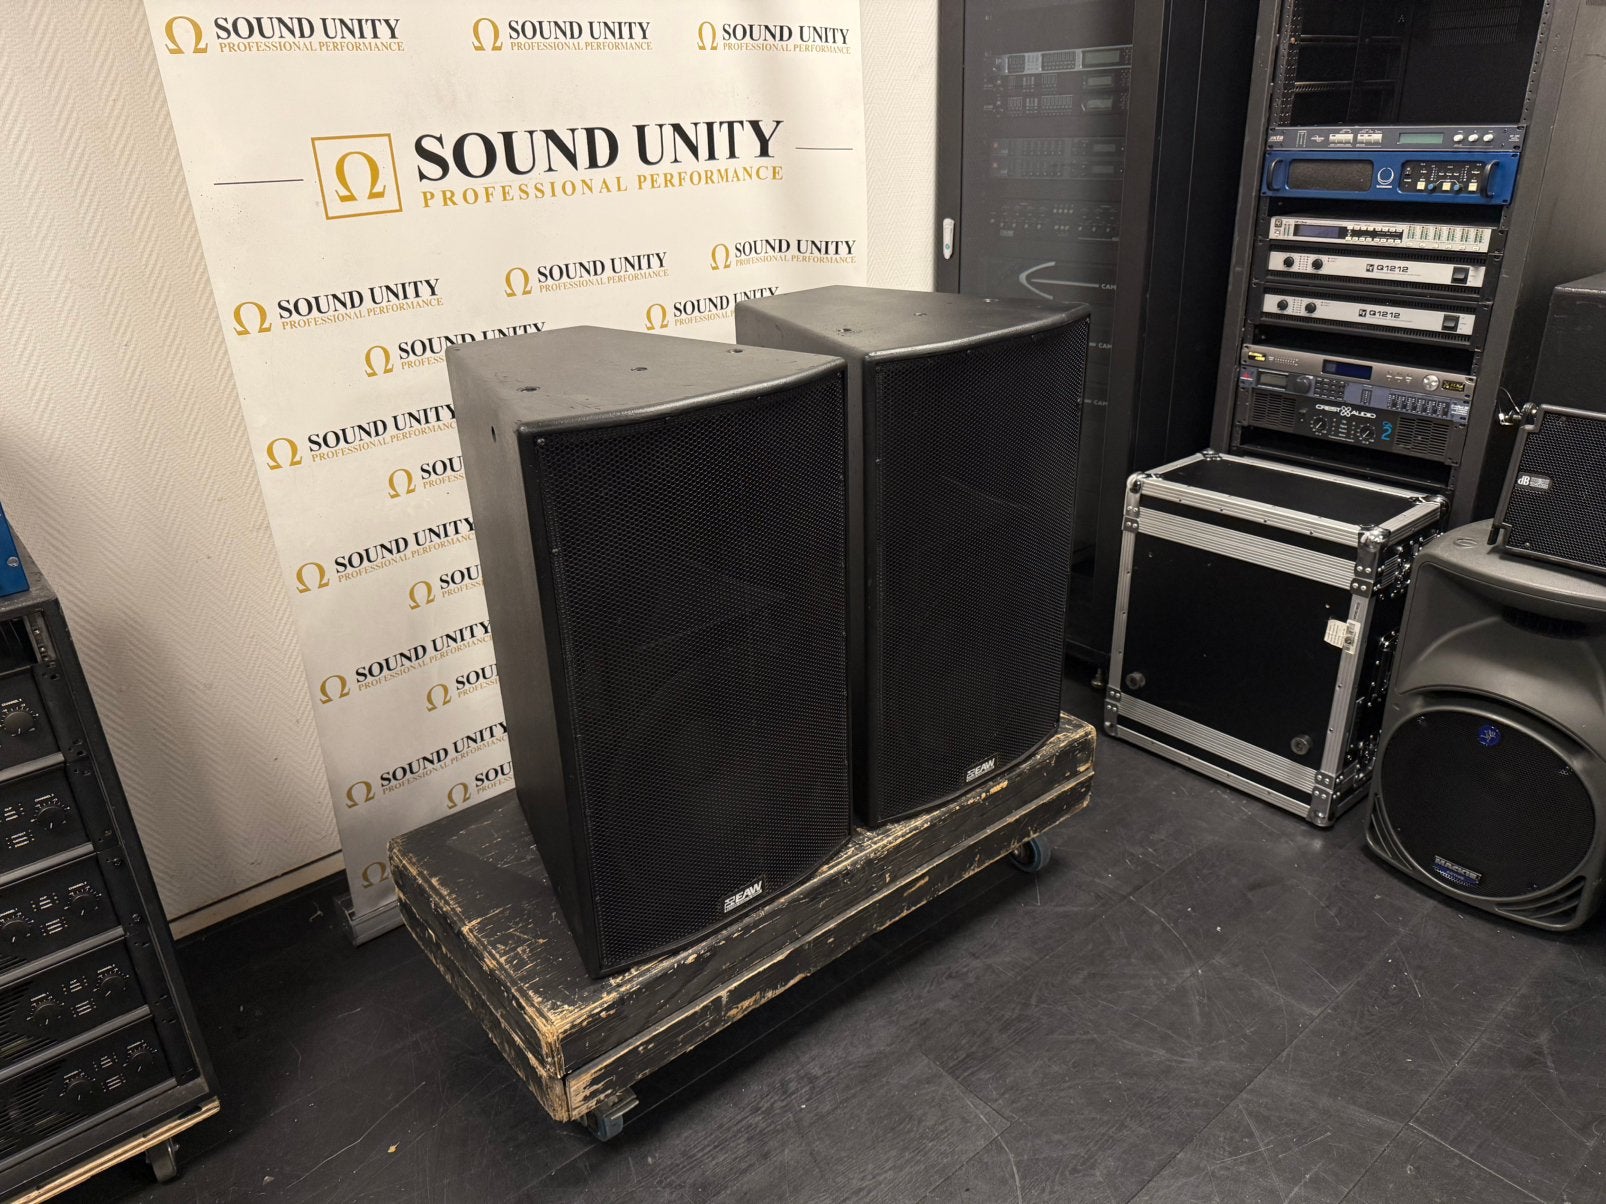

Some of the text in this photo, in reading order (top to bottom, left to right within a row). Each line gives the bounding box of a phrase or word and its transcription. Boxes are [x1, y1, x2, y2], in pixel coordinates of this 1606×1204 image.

[214, 16, 400, 40] SOUND UNITY
[508, 20, 651, 41] SOUND UNITY
[722, 23, 850, 45] SOUND UNITY
[219, 41, 405, 53] PROFESSIONAL PERFORMANCE
[510, 41, 653, 51] PROFESSIONAL PERFORMANCE
[723, 42, 852, 55] PROFESSIONAL PERFORMANCE
[414, 119, 784, 183] SOUND UNITY
[421, 165, 784, 208] PROFESSIONAL PERFORMANCE
[734, 238, 857, 258] SOUND UNITY
[537, 251, 668, 284] SOUND UNITY
[735, 254, 857, 267] PROFESSIONAL PERFORMANCE
[1376, 264, 1409, 273] Q1212
[539, 268, 670, 294] PROFESSIONAL PERFORMANCE
[277, 278, 440, 320] SOUND UNITY
[673, 294, 730, 318] SOUND
[281, 297, 444, 331] PROFESSIONAL PERFORMANCE
[674, 311, 731, 326] PROFESSIONAL
[1369, 310, 1401, 319] Q1212
[401, 355, 446, 370] PROFESS
[307, 403, 456, 453] SOUND UNITY
[311, 421, 457, 463] PROFESSIONAL PERFORMANC
[420, 455, 463, 480] SOU
[423, 472, 465, 490] PROFESS
[334, 517, 475, 574] SOUND UNITY
[338, 533, 475, 583] PROFESSIONAL PERFORMANC
[439, 564, 480, 590] SOU
[441, 581, 482, 598] PROFESS
[355, 620, 491, 684] SOUND UNITY
[455, 664, 498, 691] SOU
[457, 678, 499, 698] PROFESSI
[380, 721, 508, 788] SOUND UNITY
[450, 735, 507, 765] PERFORMANC
[475, 761, 513, 788] SOU
[477, 776, 513, 795] PROFESS
